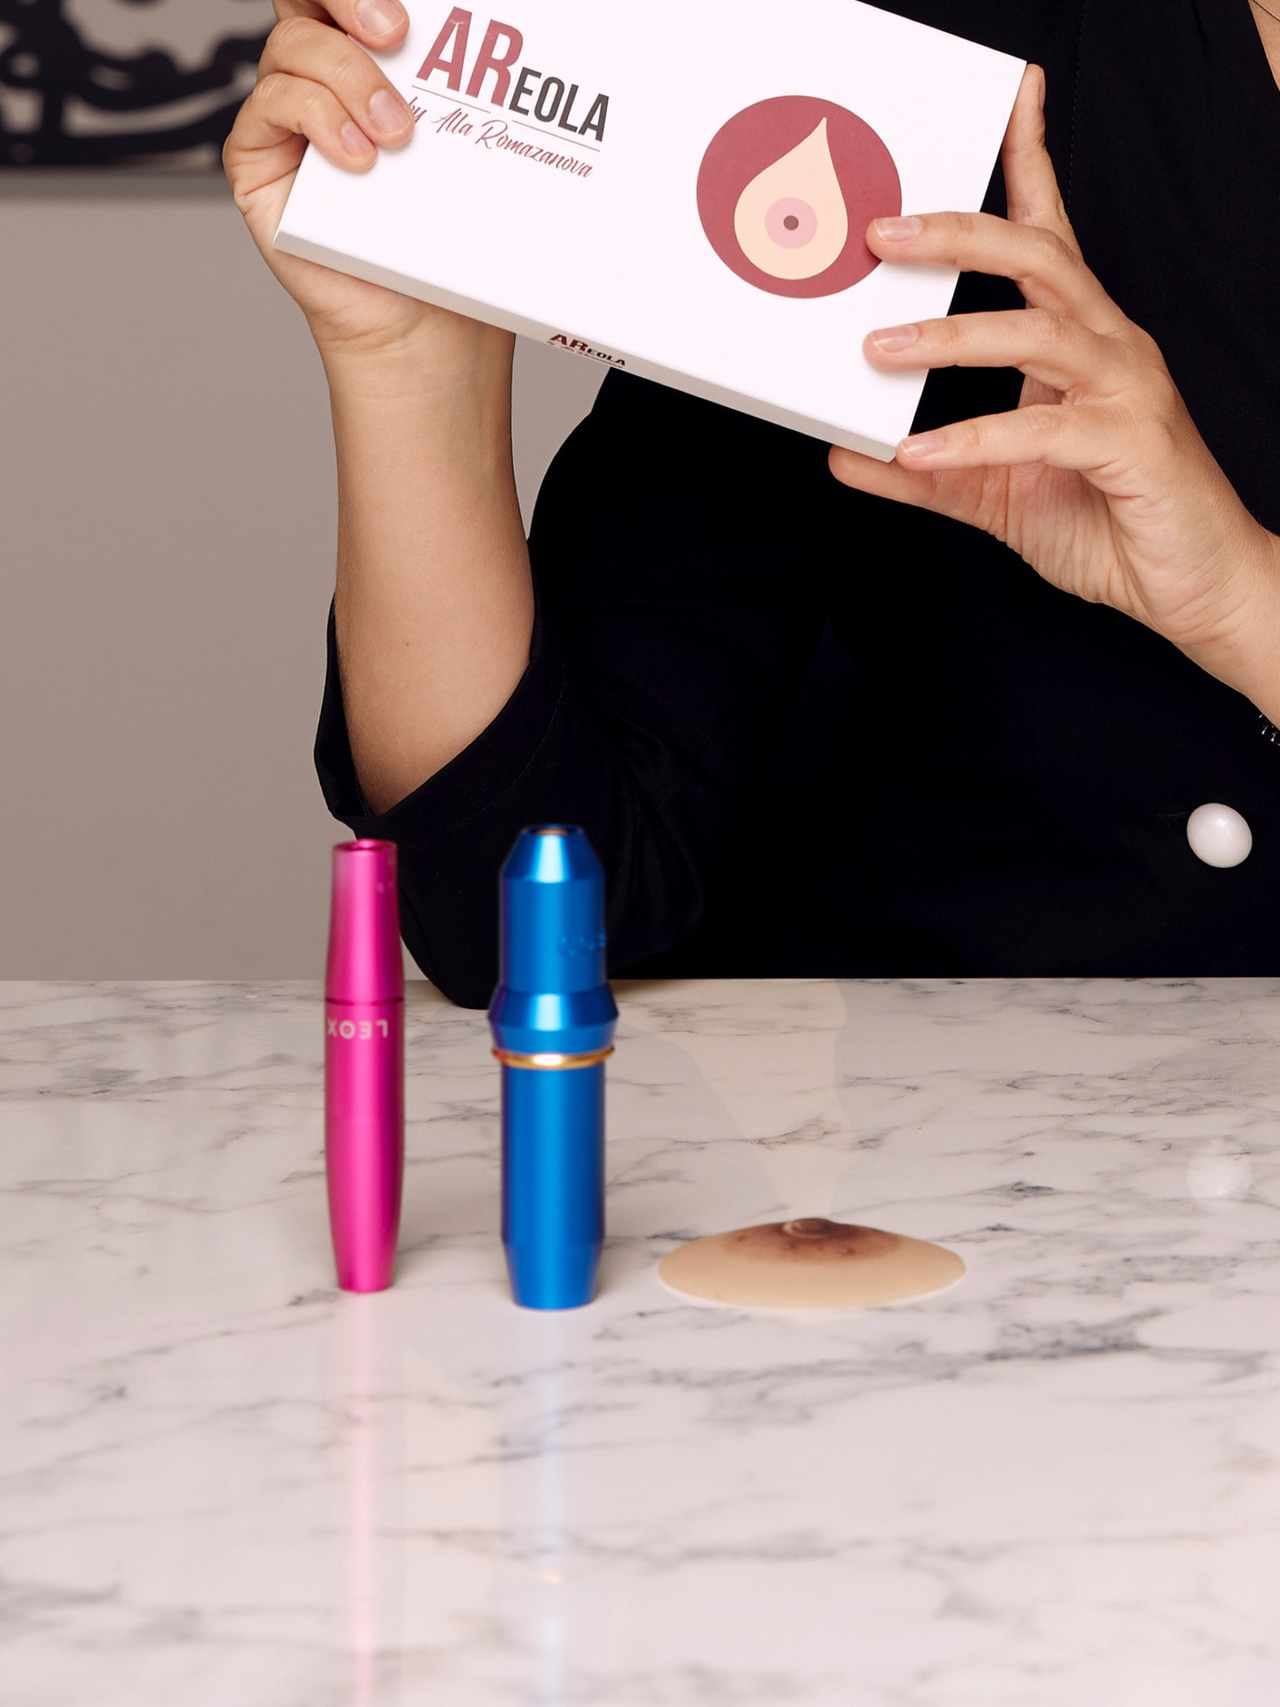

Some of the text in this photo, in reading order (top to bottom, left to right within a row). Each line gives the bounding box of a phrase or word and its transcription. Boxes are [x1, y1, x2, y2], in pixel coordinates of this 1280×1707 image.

[415, 5, 610, 142] AREOLA
[475, 119, 593, 178] Romazanova
[549, 333, 626, 366] AREOLA
[326, 1018, 389, 1040] LEOX
